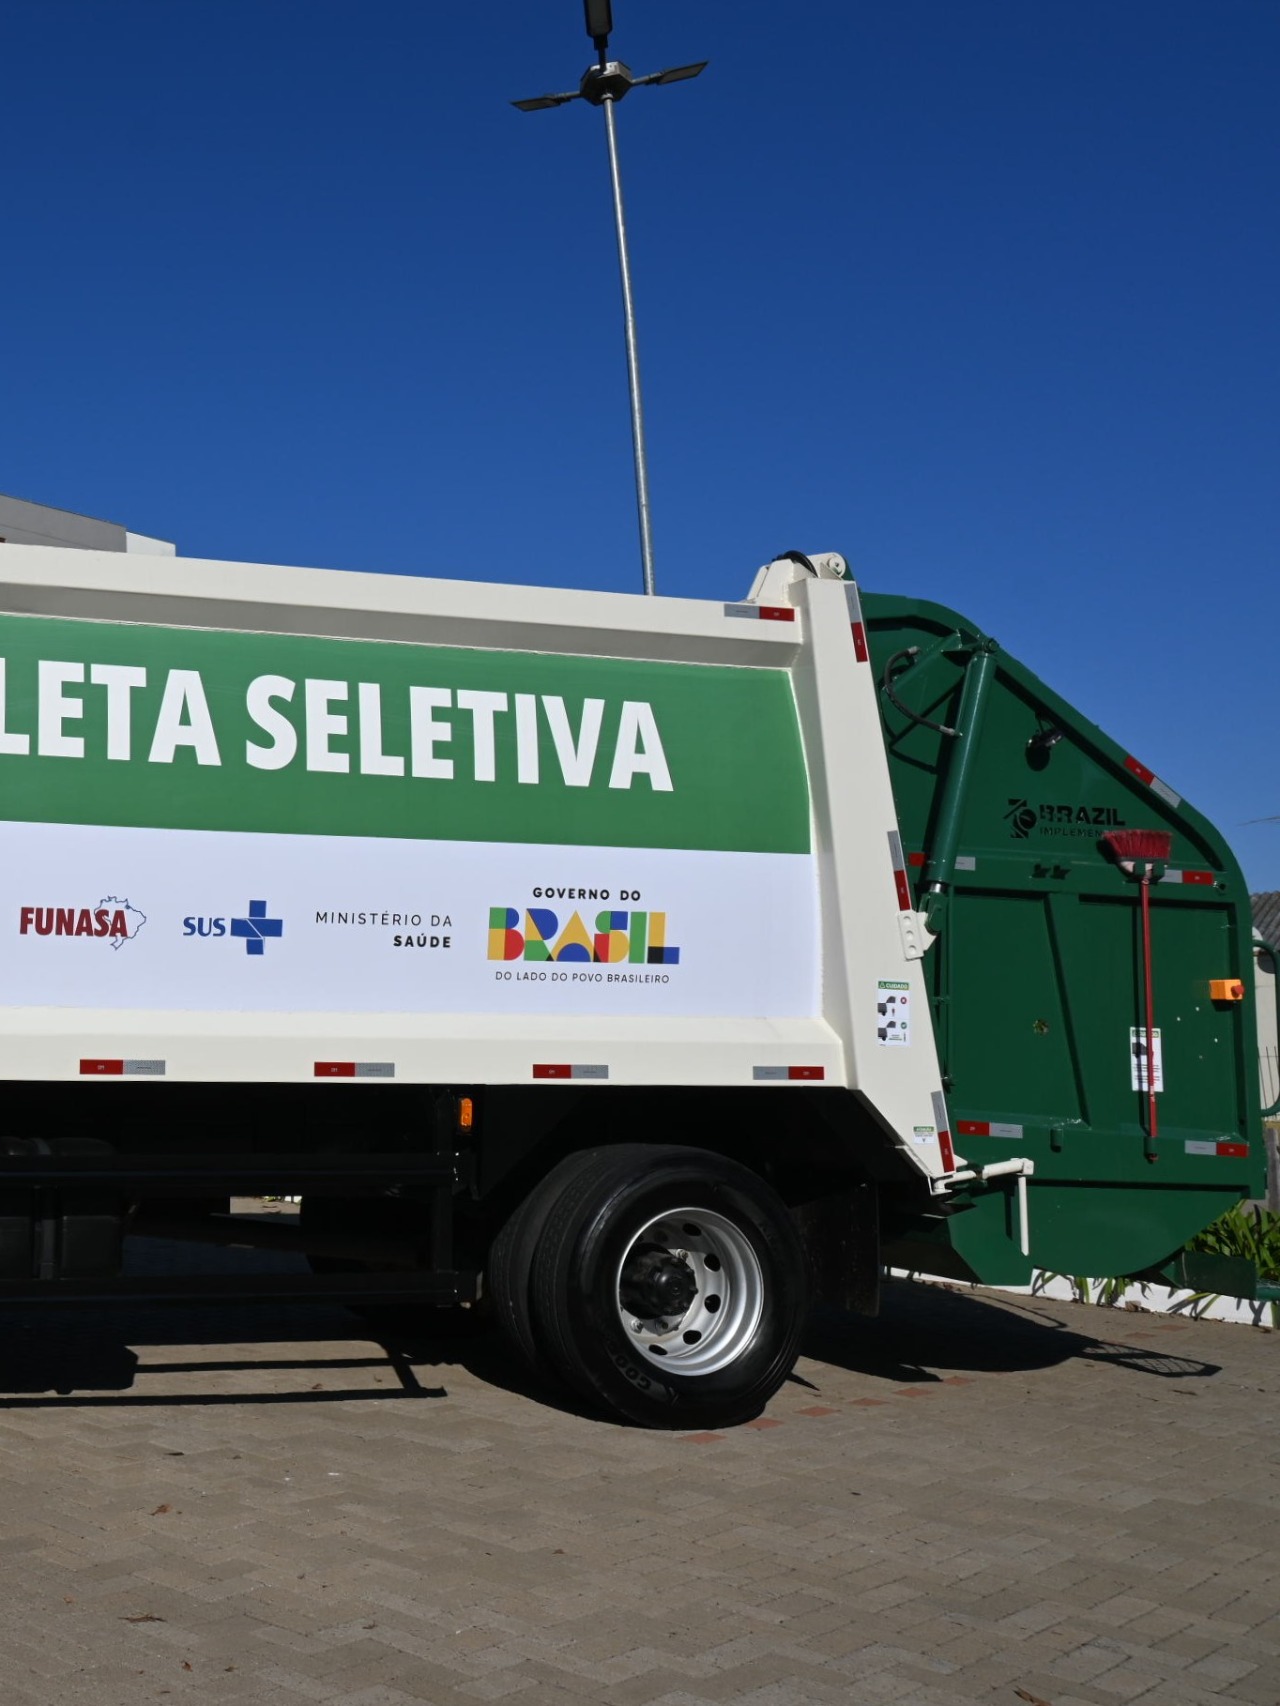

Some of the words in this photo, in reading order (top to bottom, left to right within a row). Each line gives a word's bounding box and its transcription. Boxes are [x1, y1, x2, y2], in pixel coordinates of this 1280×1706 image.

[246, 674, 674, 793] SELETIVA
[1039, 804, 1125, 827] BRAZIL
[1040, 827, 1103, 838] IMPLEMEN
[532, 886, 611, 901] GOVERNO
[619, 889, 641, 902] DO
[19, 906, 128, 938] FUNASA
[182, 916, 226, 938] SUS
[315, 909, 422, 928] MINISTÉRIO
[430, 914, 453, 928] DA
[392, 932, 451, 949] SAÚDE
[487, 907, 680, 965] BRASIL
[495, 971, 512, 981] DO
[516, 971, 547, 982] LADO
[551, 972, 568, 982] DO
[572, 972, 603, 983] POVO
[607, 973, 670, 984] BRASILEIRO
